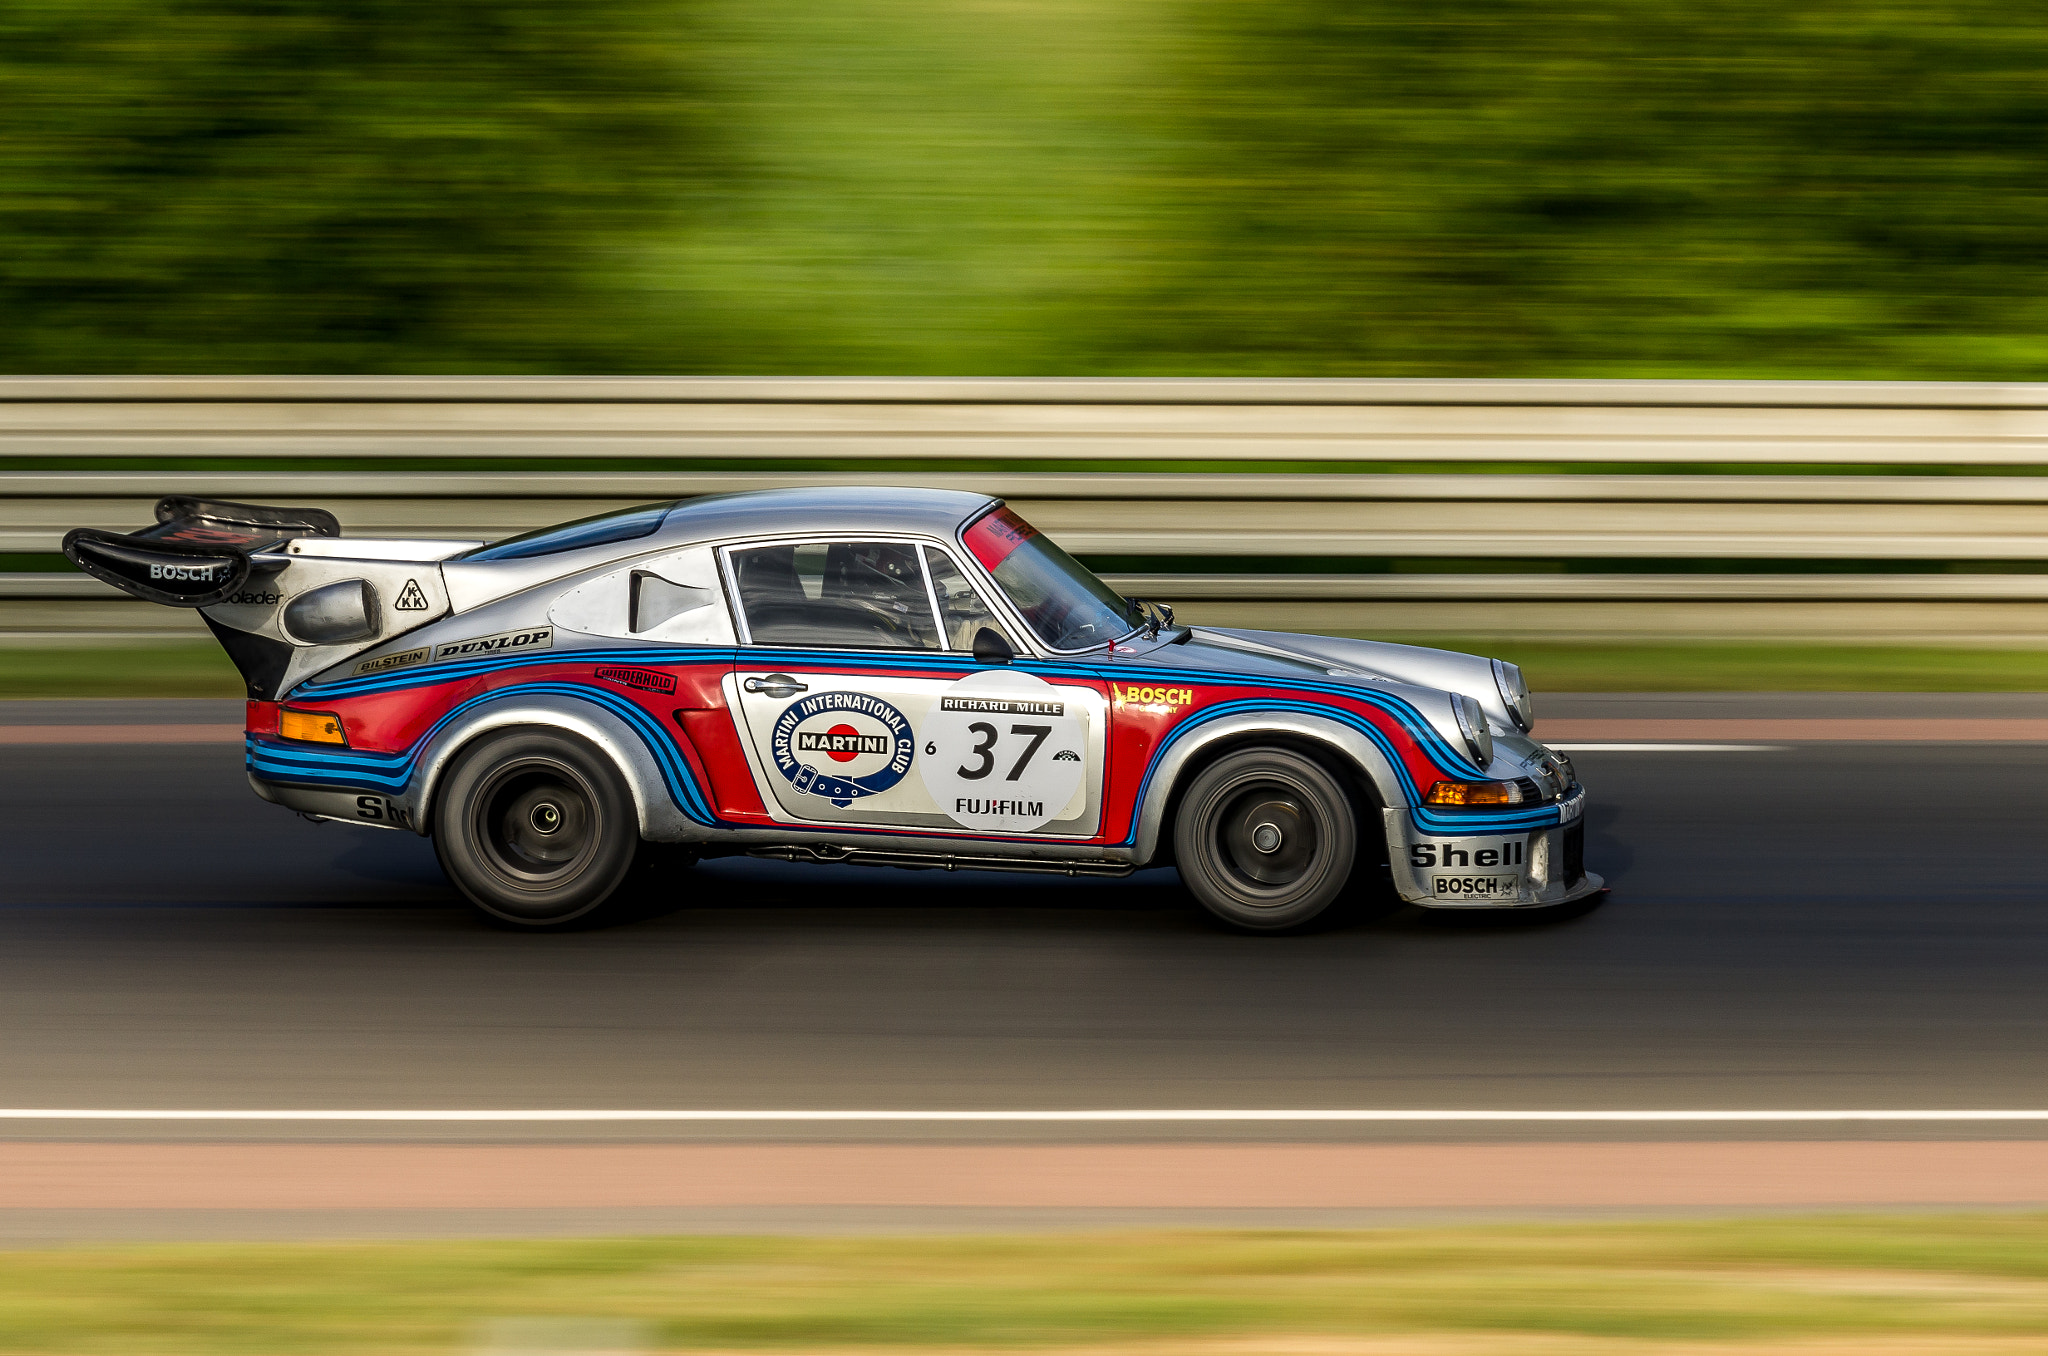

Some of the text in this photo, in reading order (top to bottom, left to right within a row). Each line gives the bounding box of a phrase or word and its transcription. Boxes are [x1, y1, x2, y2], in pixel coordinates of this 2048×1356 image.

[150, 564, 213, 581] BOSCH
[222, 590, 284, 605] olader
[438, 631, 550, 657] DUNLOP
[361, 651, 423, 671] BILSTEIN
[601, 669, 672, 689] WIEDERHOLD
[1126, 686, 1193, 705] BOSCH
[944, 699, 1061, 713] RICHARD MILLE
[775, 694, 912, 774] MARTINI INTERNATIONAL CLUB
[801, 734, 885, 753] MARTINI
[924, 741, 937, 755] 6
[957, 721, 1052, 781] 37
[955, 798, 1043, 816] FUJIFILM
[1410, 841, 1522, 868] Shell
[1436, 877, 1498, 894] BOSCH
